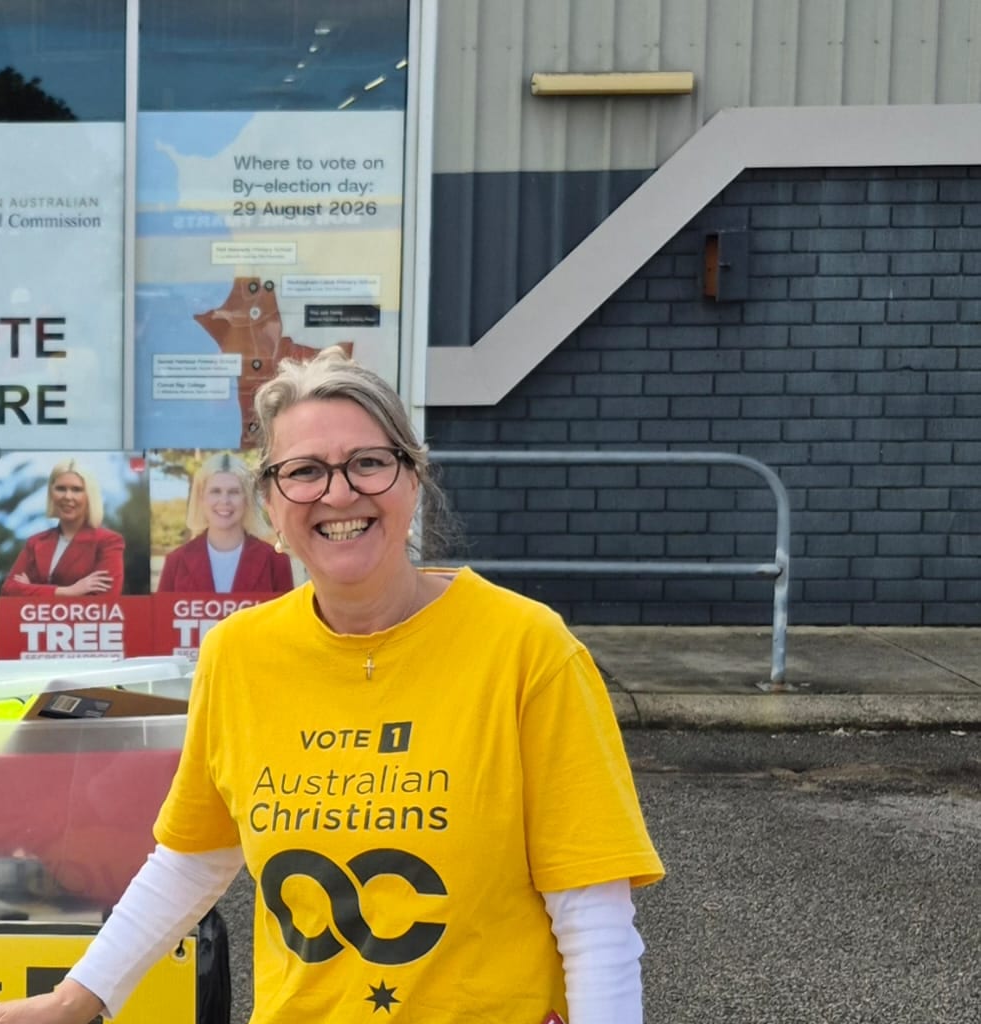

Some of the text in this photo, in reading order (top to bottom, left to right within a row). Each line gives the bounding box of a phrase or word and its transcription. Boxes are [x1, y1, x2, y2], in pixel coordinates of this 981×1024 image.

[234, 156, 384, 170] Where to vote on
[233, 178, 374, 196] By-election day:
[9, 197, 99, 208] AUSTRALIAN
[233, 201, 377, 219] 29 August 2026
[8, 213, 101, 228] Commission
[20, 604, 124, 621] GEORGIA
[173, 600, 260, 617] GEOR
[20, 623, 124, 651] TREE
[300, 727, 404, 749] VOTE 1
[253, 765, 449, 795] Australian
[250, 800, 448, 832] Christians
